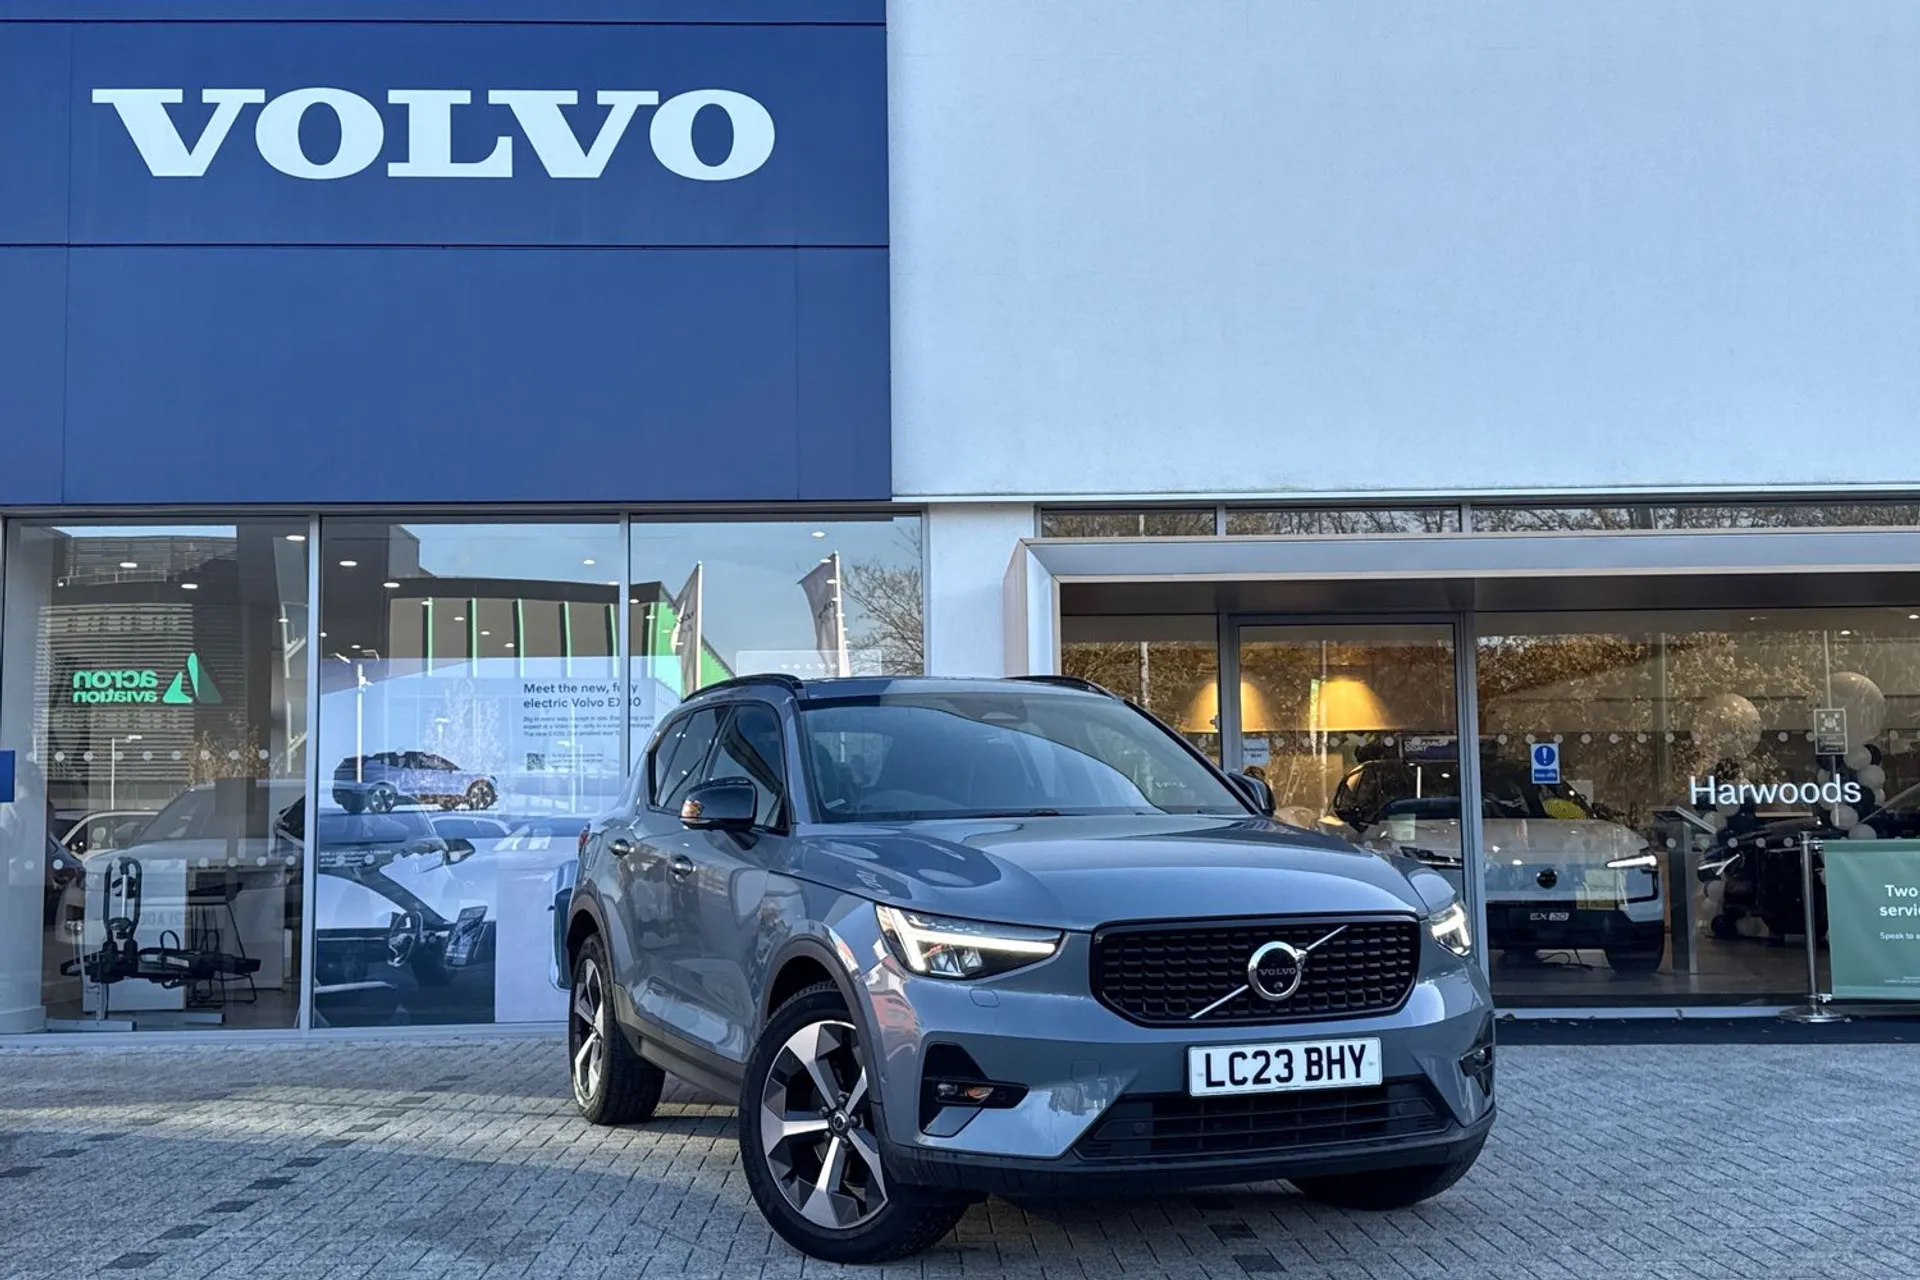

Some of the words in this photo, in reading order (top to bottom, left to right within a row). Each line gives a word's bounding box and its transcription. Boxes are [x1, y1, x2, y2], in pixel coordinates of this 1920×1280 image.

[92, 87, 776, 181] VOLVO
[523, 683, 555, 694] Meet
[558, 683, 578, 694] the
[581, 684, 610, 695] new,
[523, 697, 568, 708] electric
[571, 697, 604, 708] Volvo
[1689, 772, 1863, 805] Harwoods
[1884, 884, 1919, 898] Two
[1879, 903, 1920, 917] servi
[1880, 932, 1904, 941] Speak
[1905, 932, 1915, 940] to
[1259, 967, 1296, 975] VOLVO
[1205, 1049, 1294, 1087] LC23
[1304, 1044, 1366, 1082] BHY
